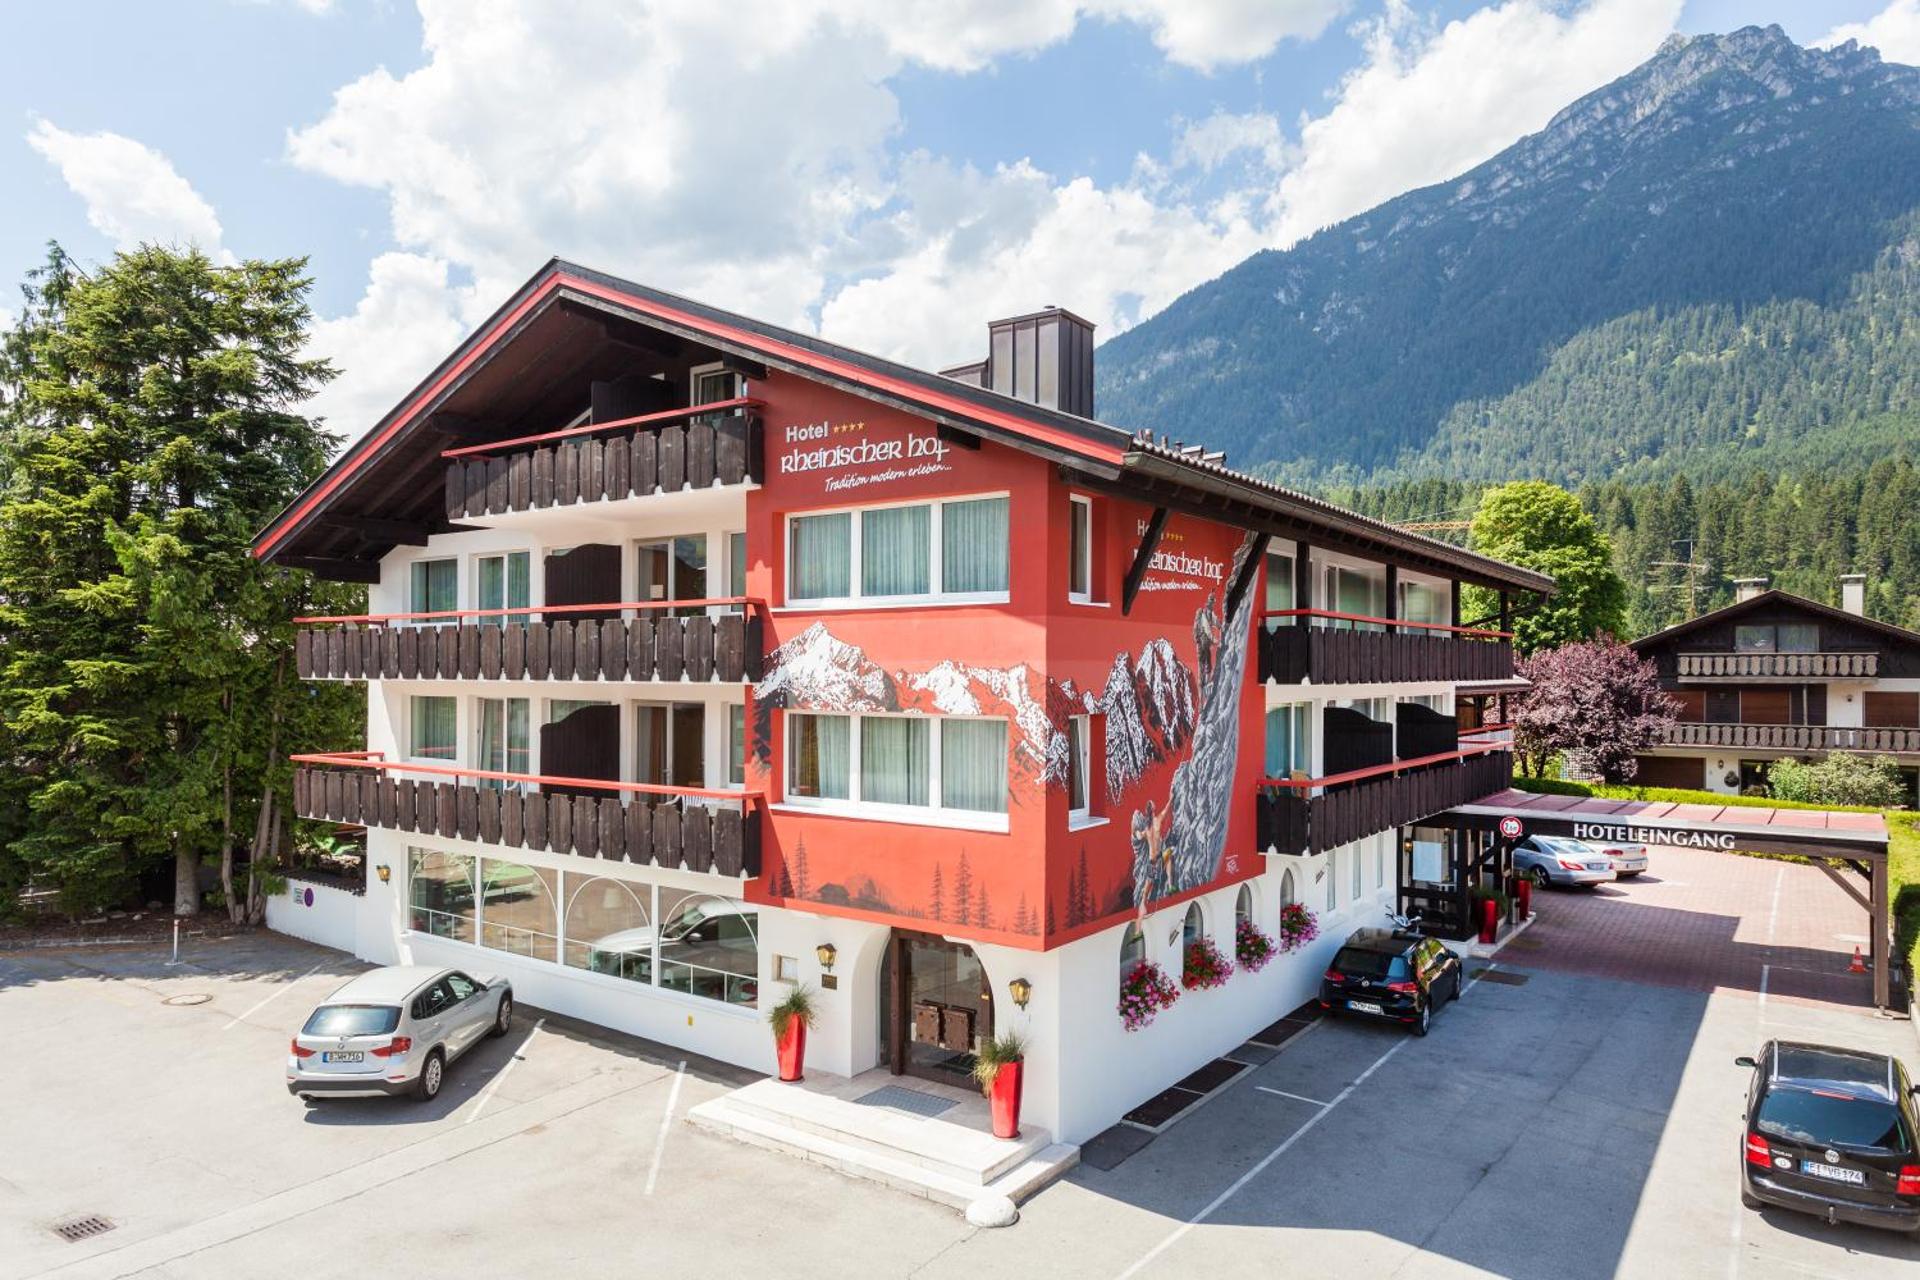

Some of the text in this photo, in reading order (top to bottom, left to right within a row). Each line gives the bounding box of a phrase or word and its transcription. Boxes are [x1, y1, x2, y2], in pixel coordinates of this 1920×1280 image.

[786, 421, 828, 442] Hotel
[825, 473, 869, 491] Tradition
[870, 467, 906, 483] modern
[1573, 822, 1736, 849] HOTELEINGANG
